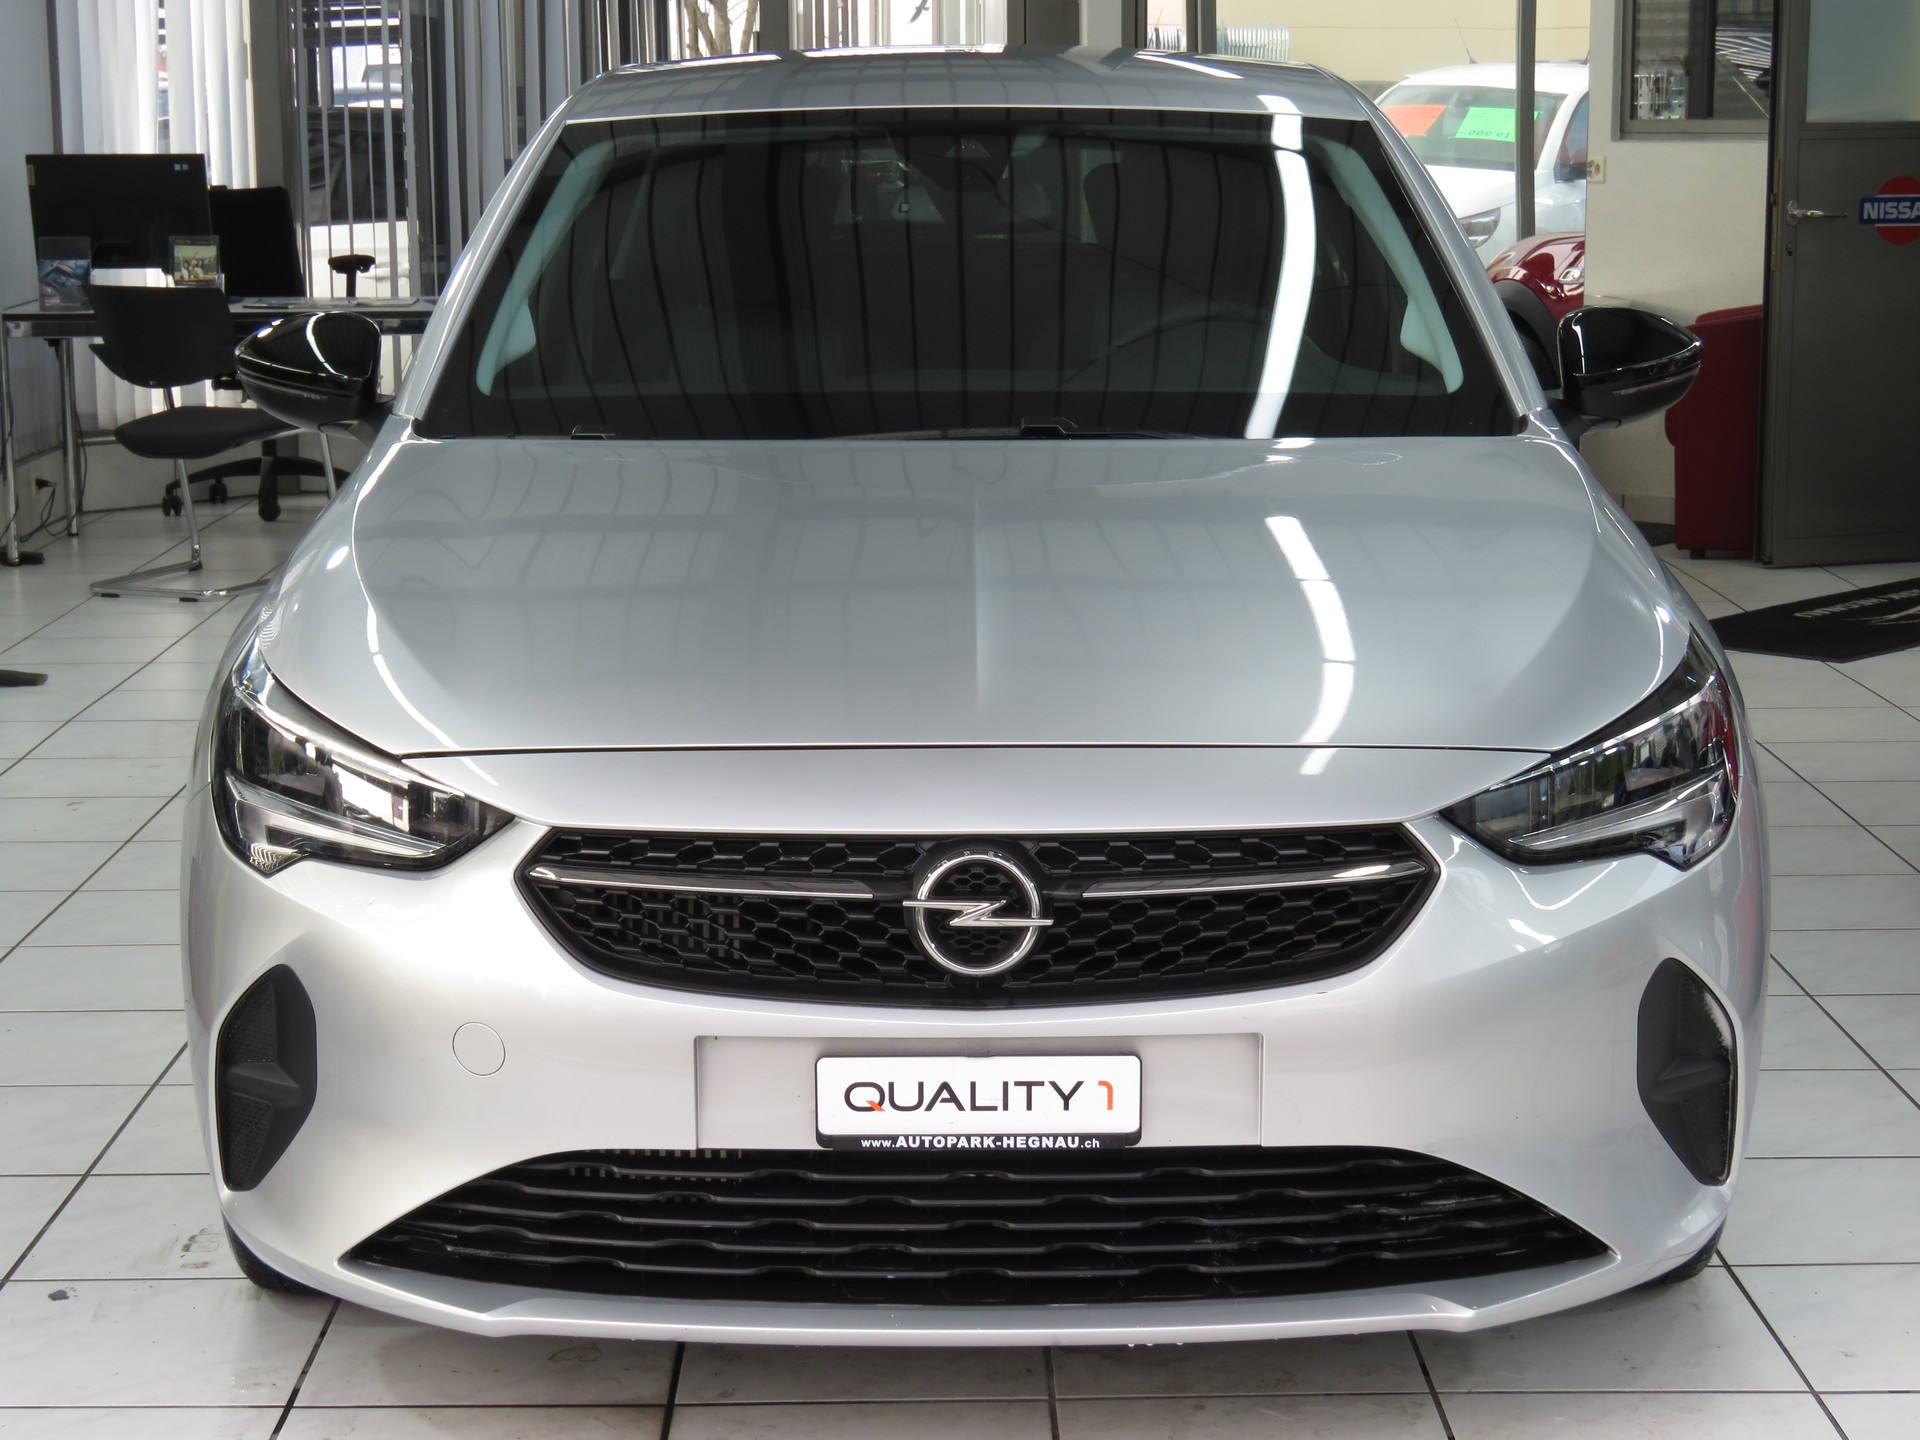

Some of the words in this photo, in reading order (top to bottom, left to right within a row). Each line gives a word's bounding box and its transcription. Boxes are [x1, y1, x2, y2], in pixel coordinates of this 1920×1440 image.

[844, 1081, 1085, 1112] QUALITY
[1098, 1080, 1113, 1111] 1
[861, 1136, 1100, 1149] www.AUTOPARK-HEGNAU.ch
